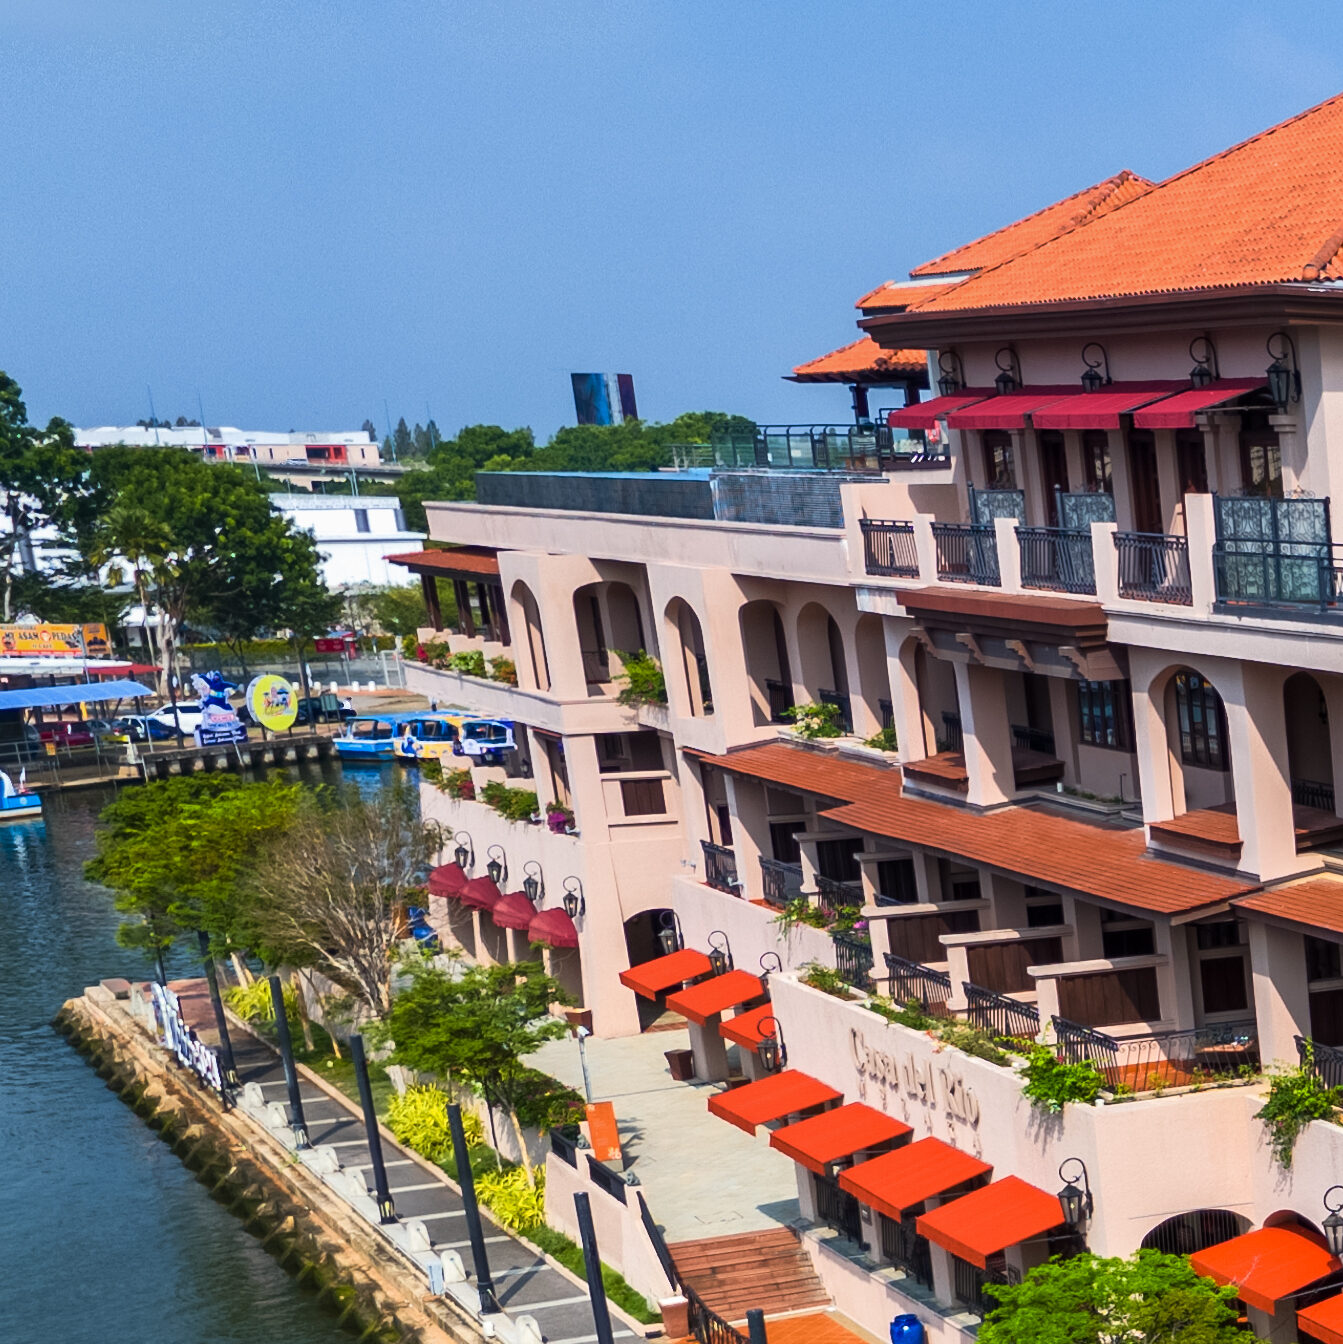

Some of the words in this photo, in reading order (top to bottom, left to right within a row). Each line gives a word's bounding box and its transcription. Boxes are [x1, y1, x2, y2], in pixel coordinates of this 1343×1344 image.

[849, 1028, 899, 1093] Casa
[902, 1051, 937, 1111] del
[938, 1067, 981, 1132] Rio
